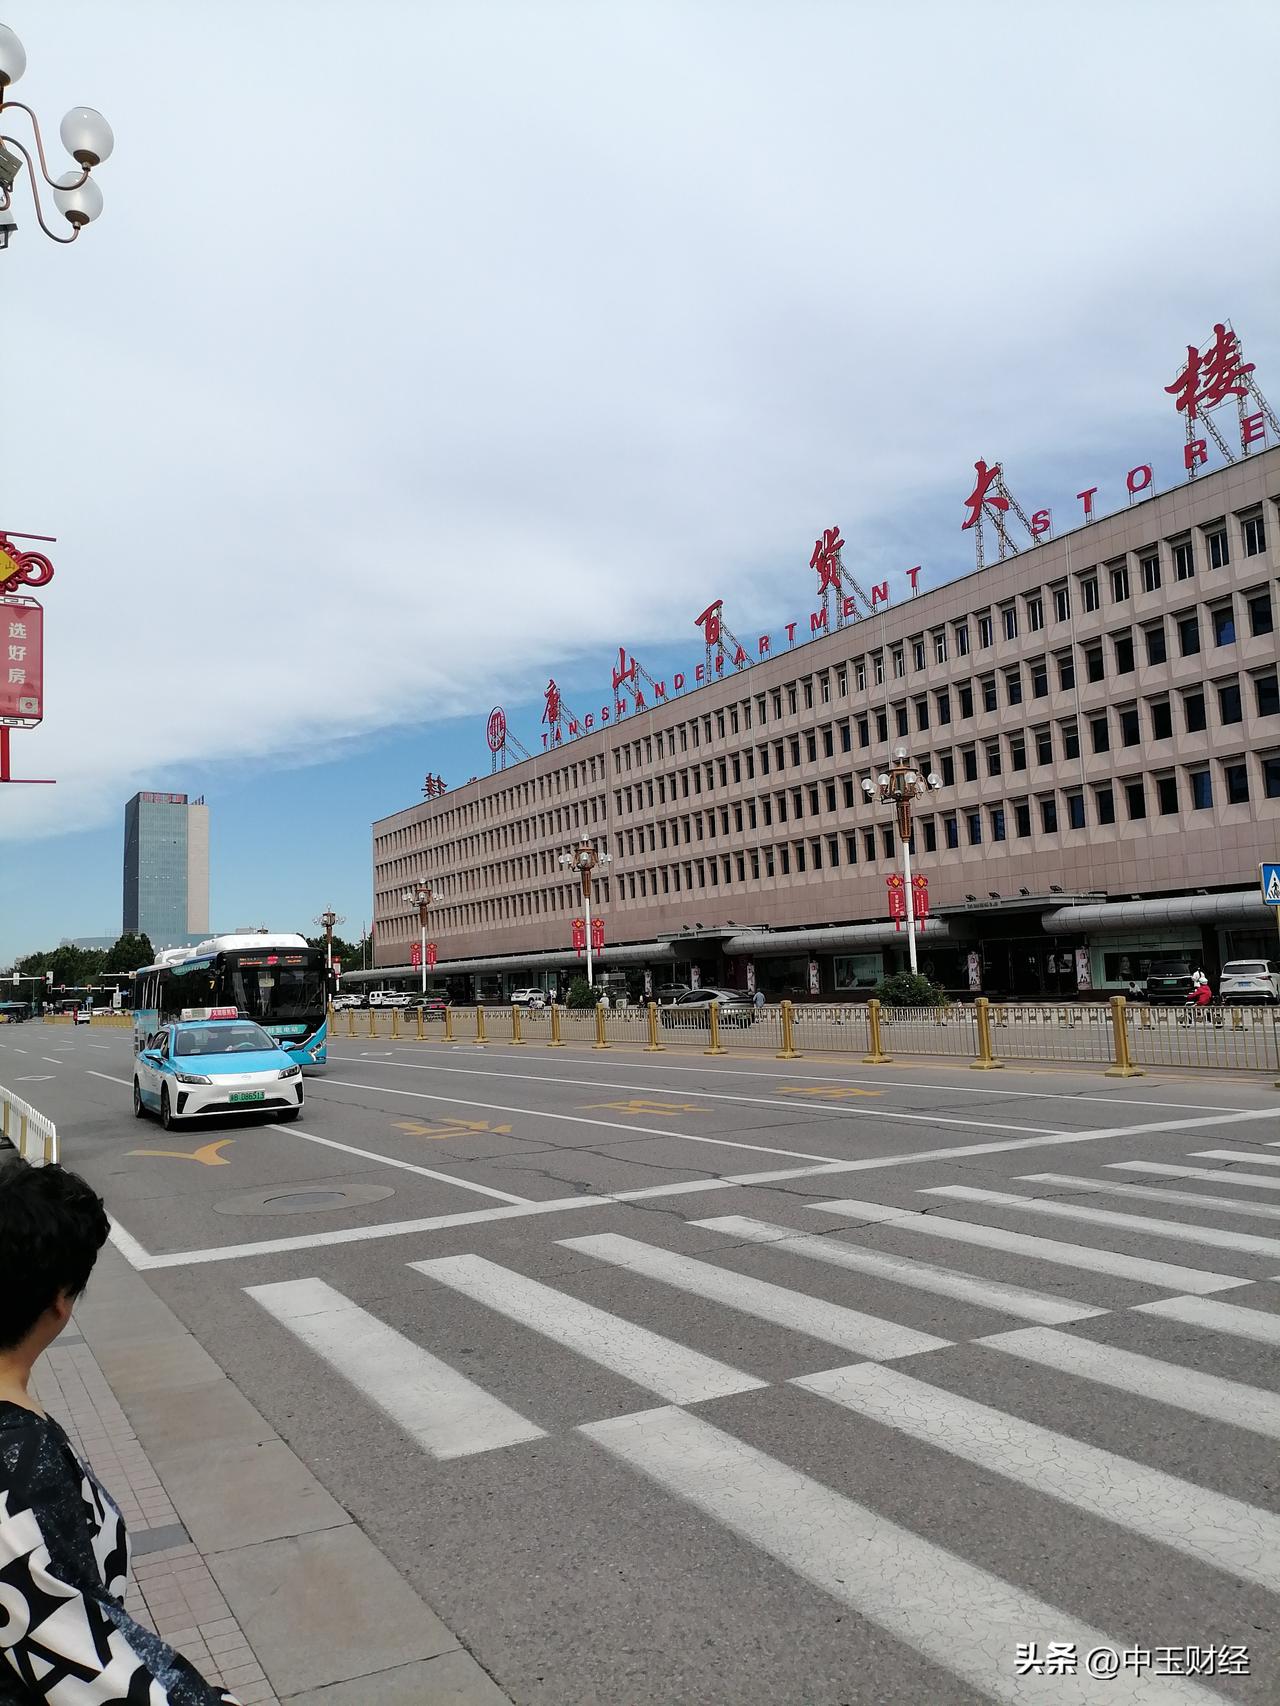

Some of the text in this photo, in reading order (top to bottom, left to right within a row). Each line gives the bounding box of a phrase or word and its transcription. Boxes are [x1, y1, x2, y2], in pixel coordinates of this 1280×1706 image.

[8, 622, 27, 684] 选好房
[541, 411, 1266, 747] TANGSHAN DEPARTMENT STORE
[542, 323, 1256, 724] 唐山百货大楼
